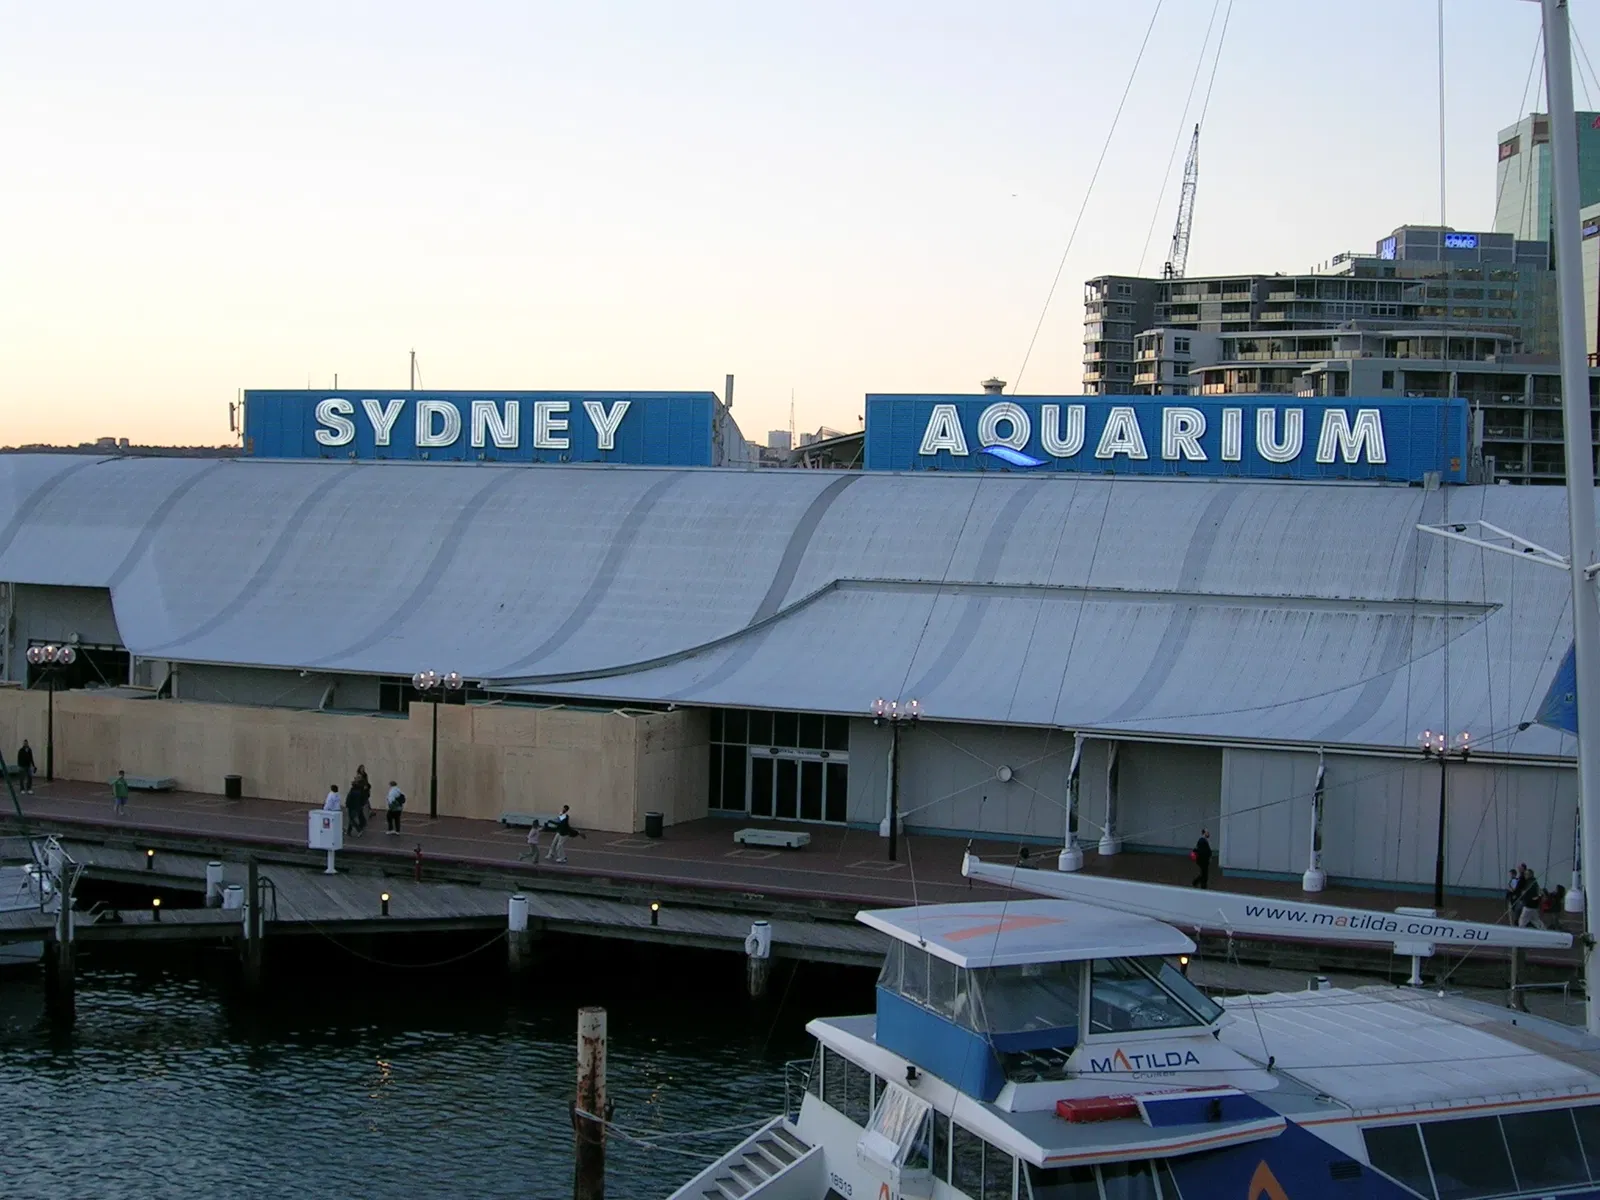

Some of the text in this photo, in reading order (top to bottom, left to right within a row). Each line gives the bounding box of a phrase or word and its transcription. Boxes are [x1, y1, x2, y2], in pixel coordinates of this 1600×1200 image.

[314, 398, 631, 450] SYDNEY
[918, 402, 1387, 464] AQUARIUM
[1245, 904, 1490, 942] www.matilda.com.au
[1090, 1048, 1200, 1073] MATILDA
